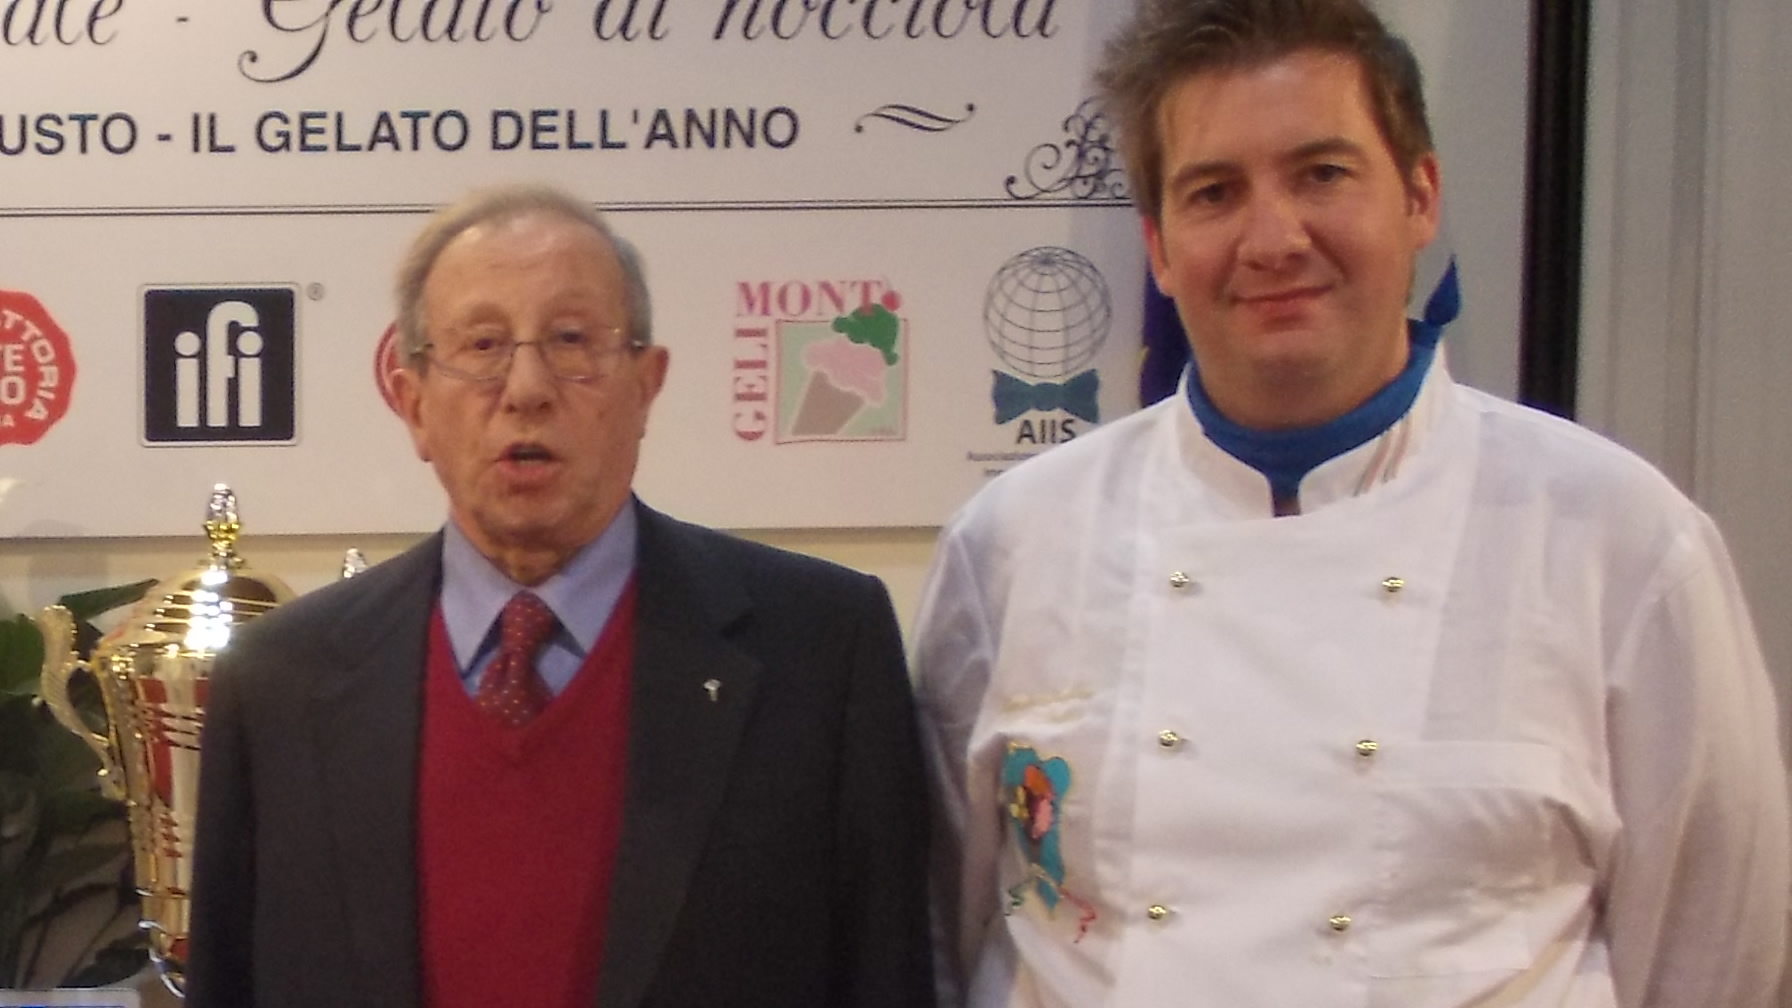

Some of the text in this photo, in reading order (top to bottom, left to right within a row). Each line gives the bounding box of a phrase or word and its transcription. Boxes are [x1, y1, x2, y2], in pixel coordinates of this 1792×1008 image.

[192, 112, 235, 153] IL
[255, 110, 470, 152] GELATO
[490, 107, 799, 151] DELL'ANNO
[737, 279, 884, 317] MONT
[174, 300, 264, 428] ifi
[734, 328, 768, 441] GELI
